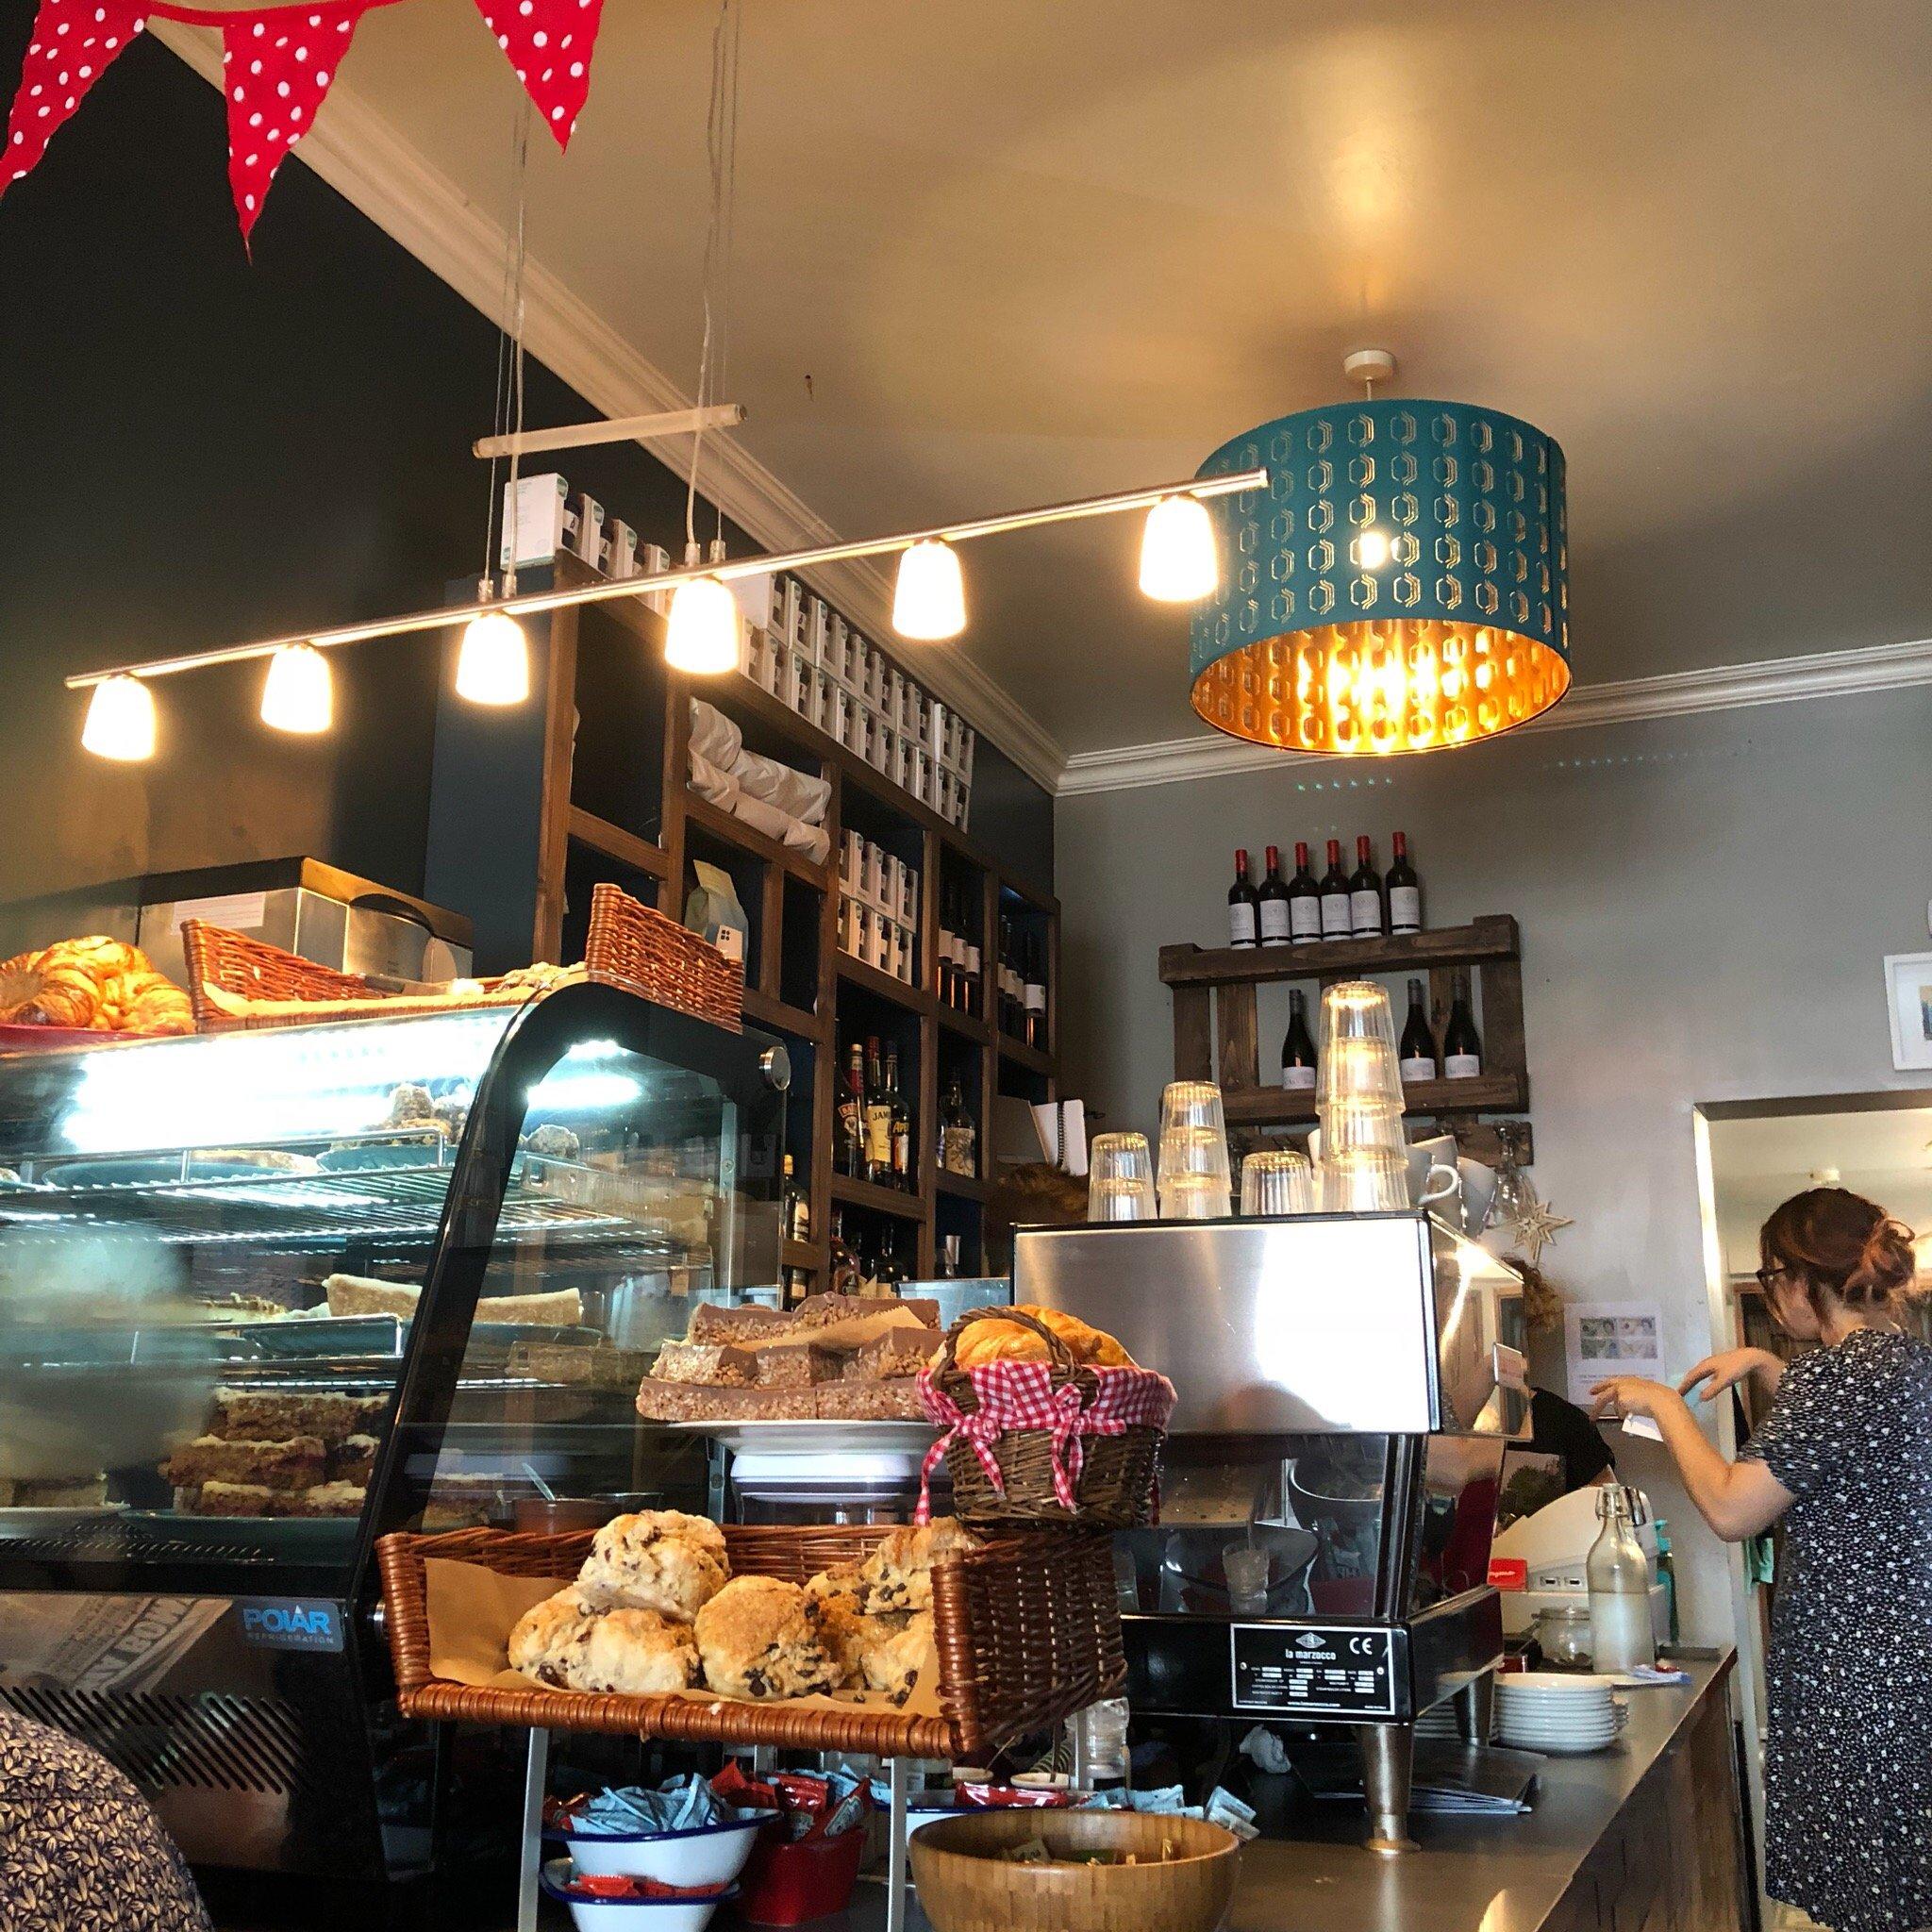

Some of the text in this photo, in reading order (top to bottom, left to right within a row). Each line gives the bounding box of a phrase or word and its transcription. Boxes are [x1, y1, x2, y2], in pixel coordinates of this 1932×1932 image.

[243, 1605, 330, 1635] POLAR
[1285, 1648, 1337, 1660] la marzocco
[1349, 1637, 1373, 1655] CE
